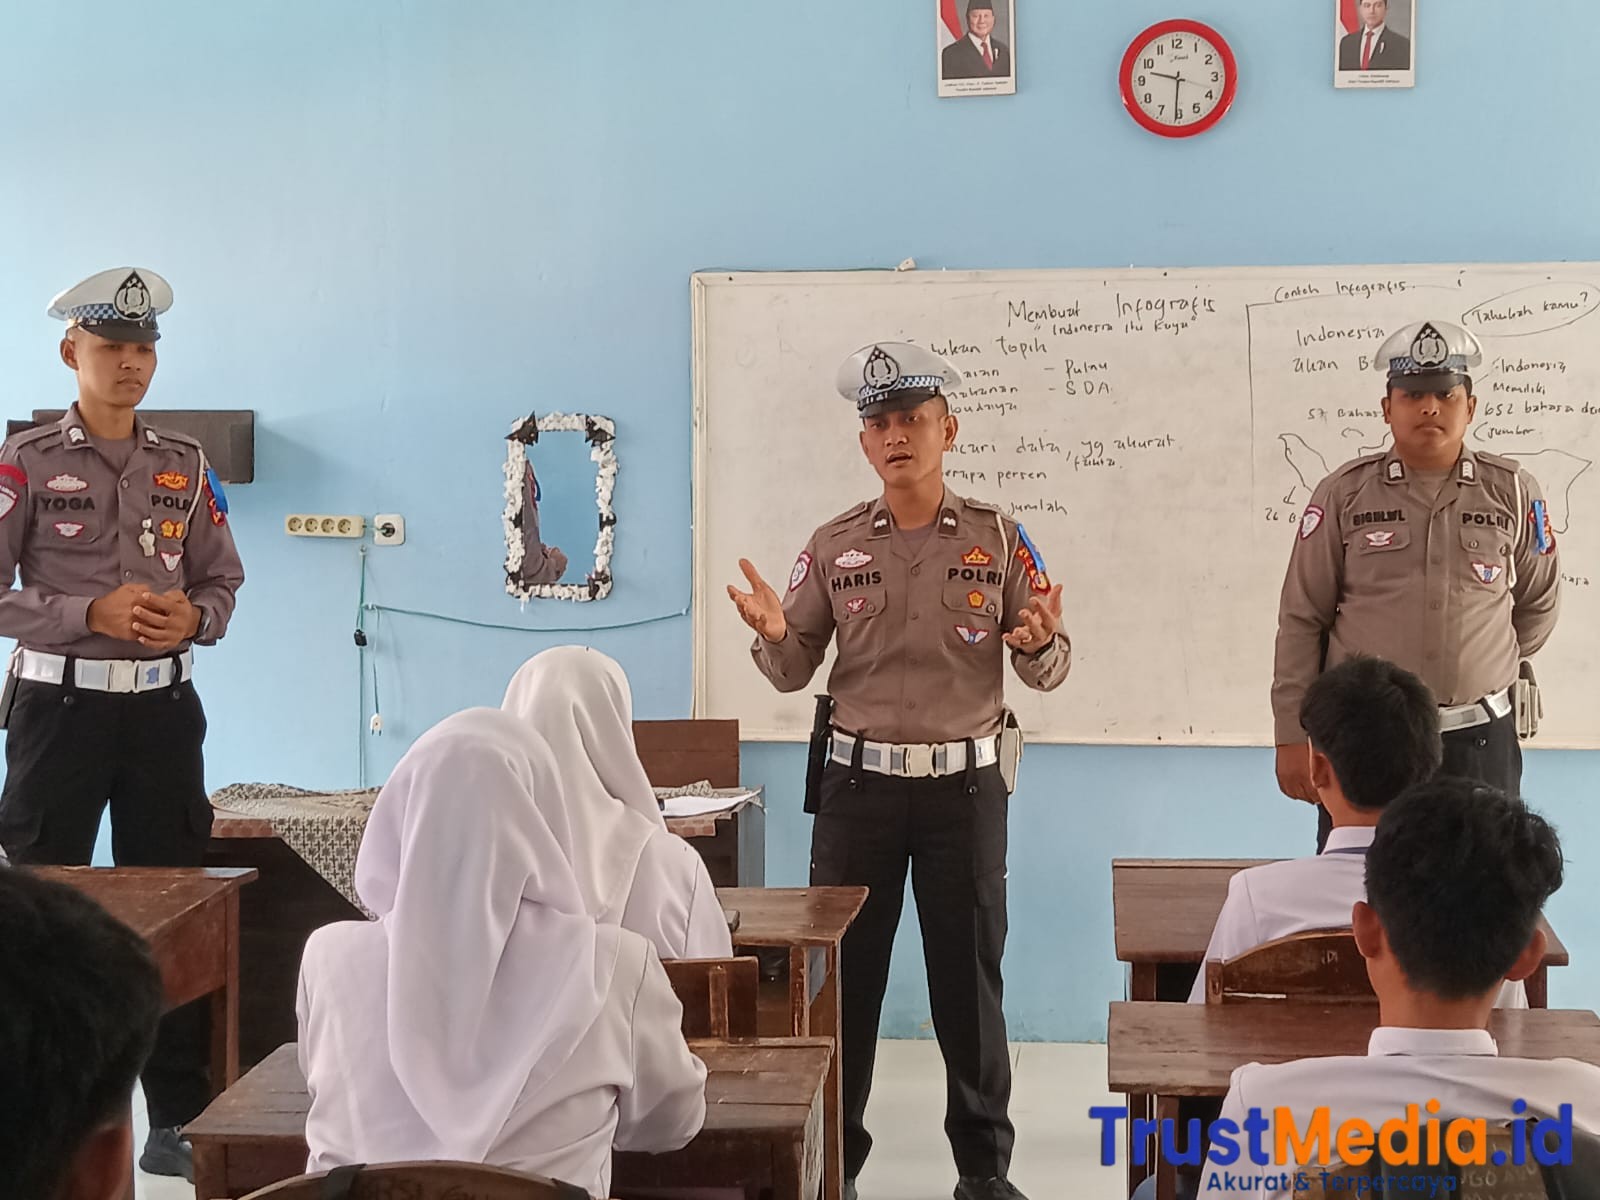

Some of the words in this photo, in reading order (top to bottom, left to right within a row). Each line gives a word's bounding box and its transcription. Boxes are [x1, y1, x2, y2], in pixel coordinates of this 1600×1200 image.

[1156, 44, 1164, 56] 11
[1171, 38, 1183, 50] 12
[1194, 42, 1198, 53] 1
[1143, 58, 1154, 69] 10
[1204, 54, 1213, 65] 2
[1137, 75, 1146, 87] 9
[1210, 71, 1219, 82] 3
[1143, 93, 1152, 104] 8
[1204, 89, 1213, 100] 4
[1158, 104, 1165, 116] 7
[1008, 299, 1081, 327] Membuat
[1115, 293, 1216, 320] Infografis
[1296, 324, 1386, 347] Indonesia
[40, 497, 96, 512] YOGA
[831, 571, 883, 593] HARIS
[948, 567, 1003, 587] POLRI
